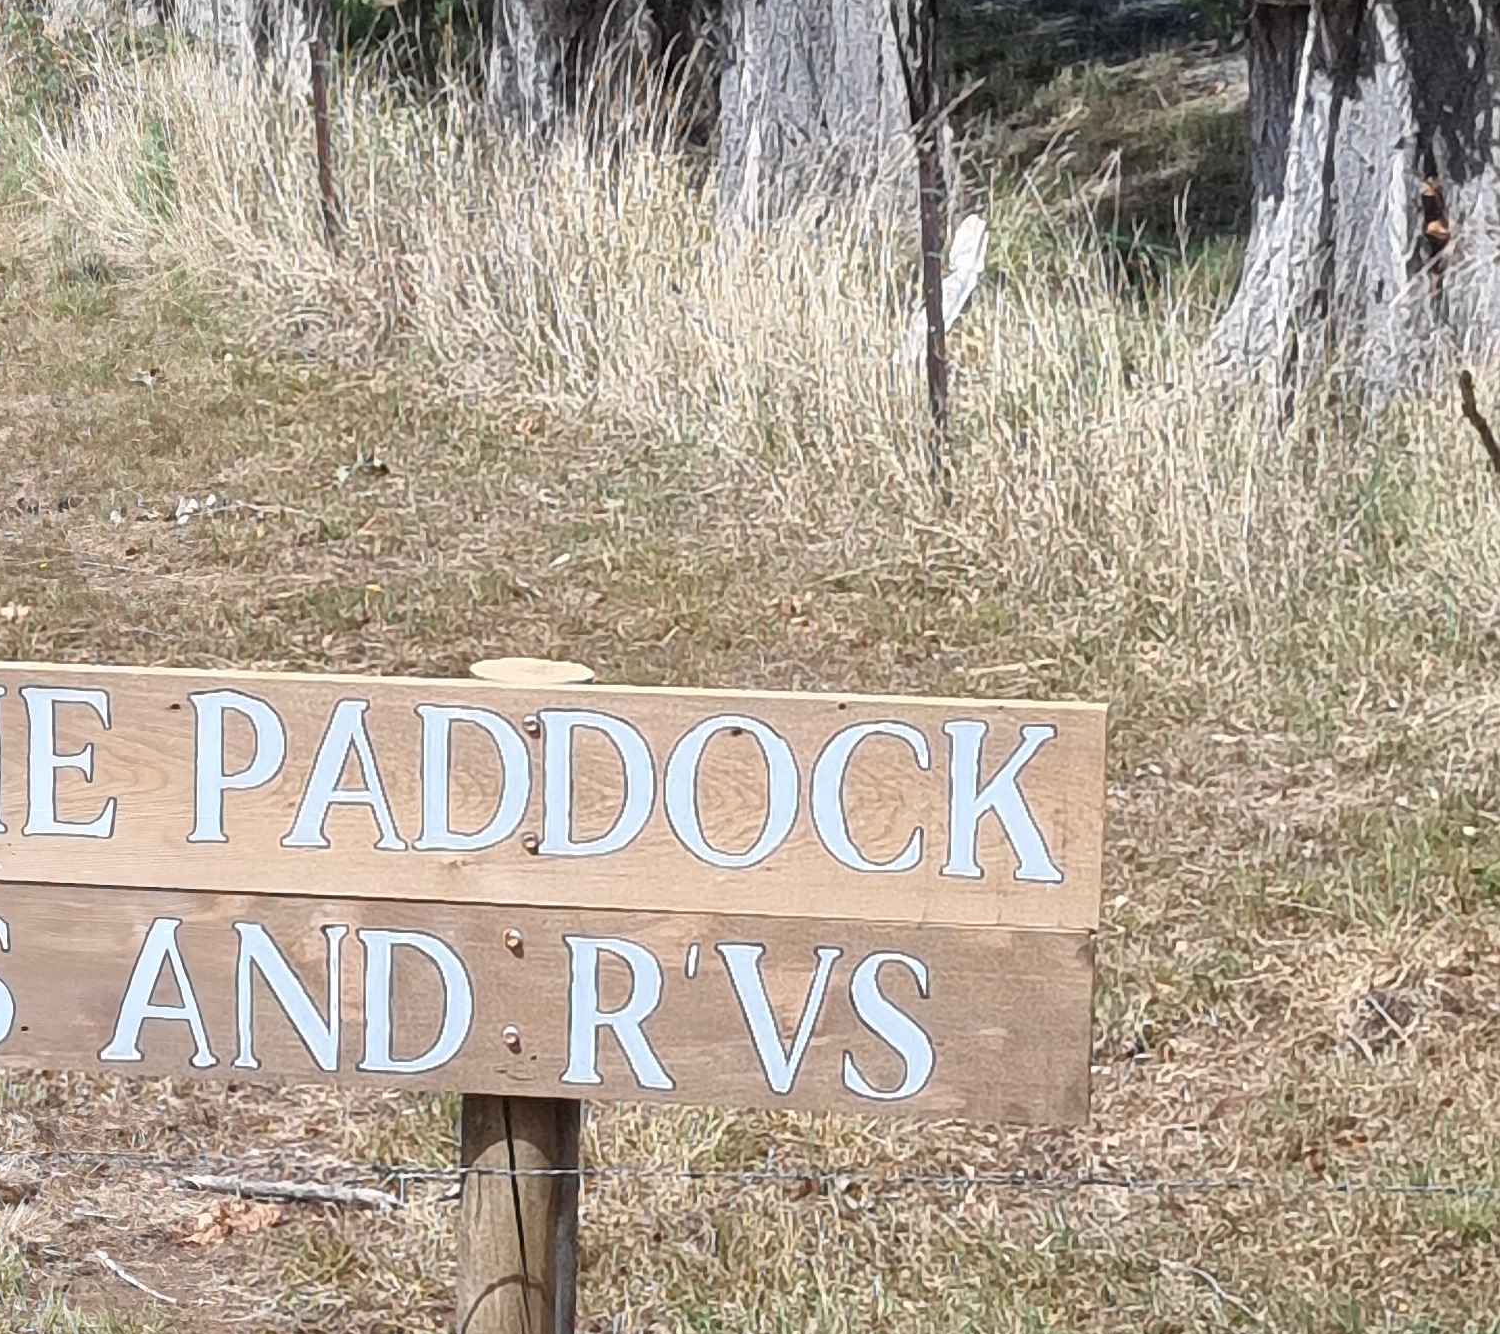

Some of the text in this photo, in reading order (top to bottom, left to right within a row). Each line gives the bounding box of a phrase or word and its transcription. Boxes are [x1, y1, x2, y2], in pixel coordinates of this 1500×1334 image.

[187, 688, 1063, 884] PADDOCK
[99, 917, 474, 1072] AND
[560, 934, 935, 1101] R'VS
